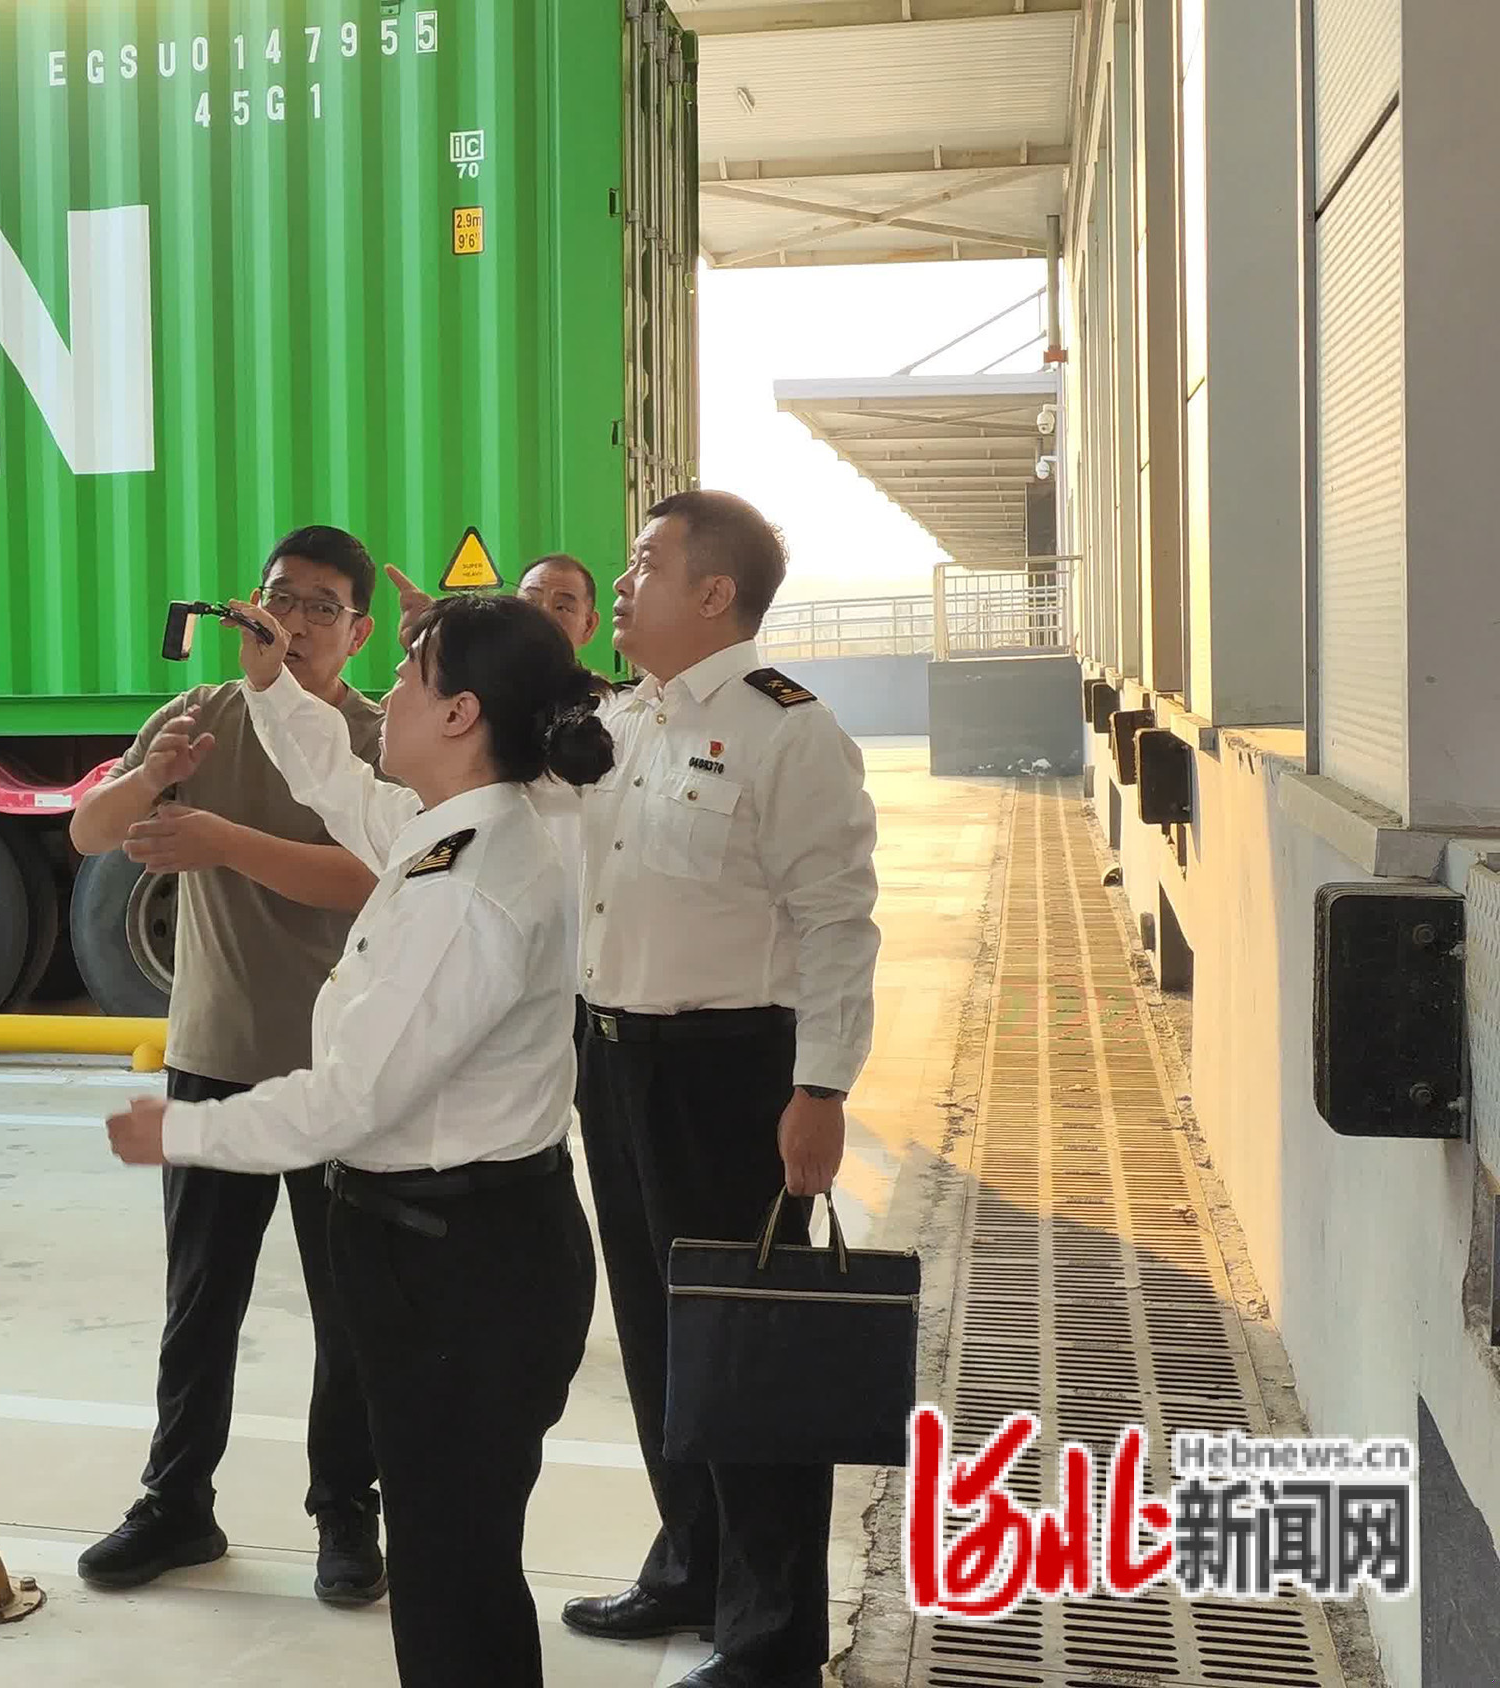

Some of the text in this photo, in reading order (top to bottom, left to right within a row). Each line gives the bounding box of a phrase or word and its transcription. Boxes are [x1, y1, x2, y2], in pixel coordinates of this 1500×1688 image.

[194, 83, 323, 128] 45G1
[456, 162, 479, 179] 70
[456, 212, 482, 229] 2.9m
